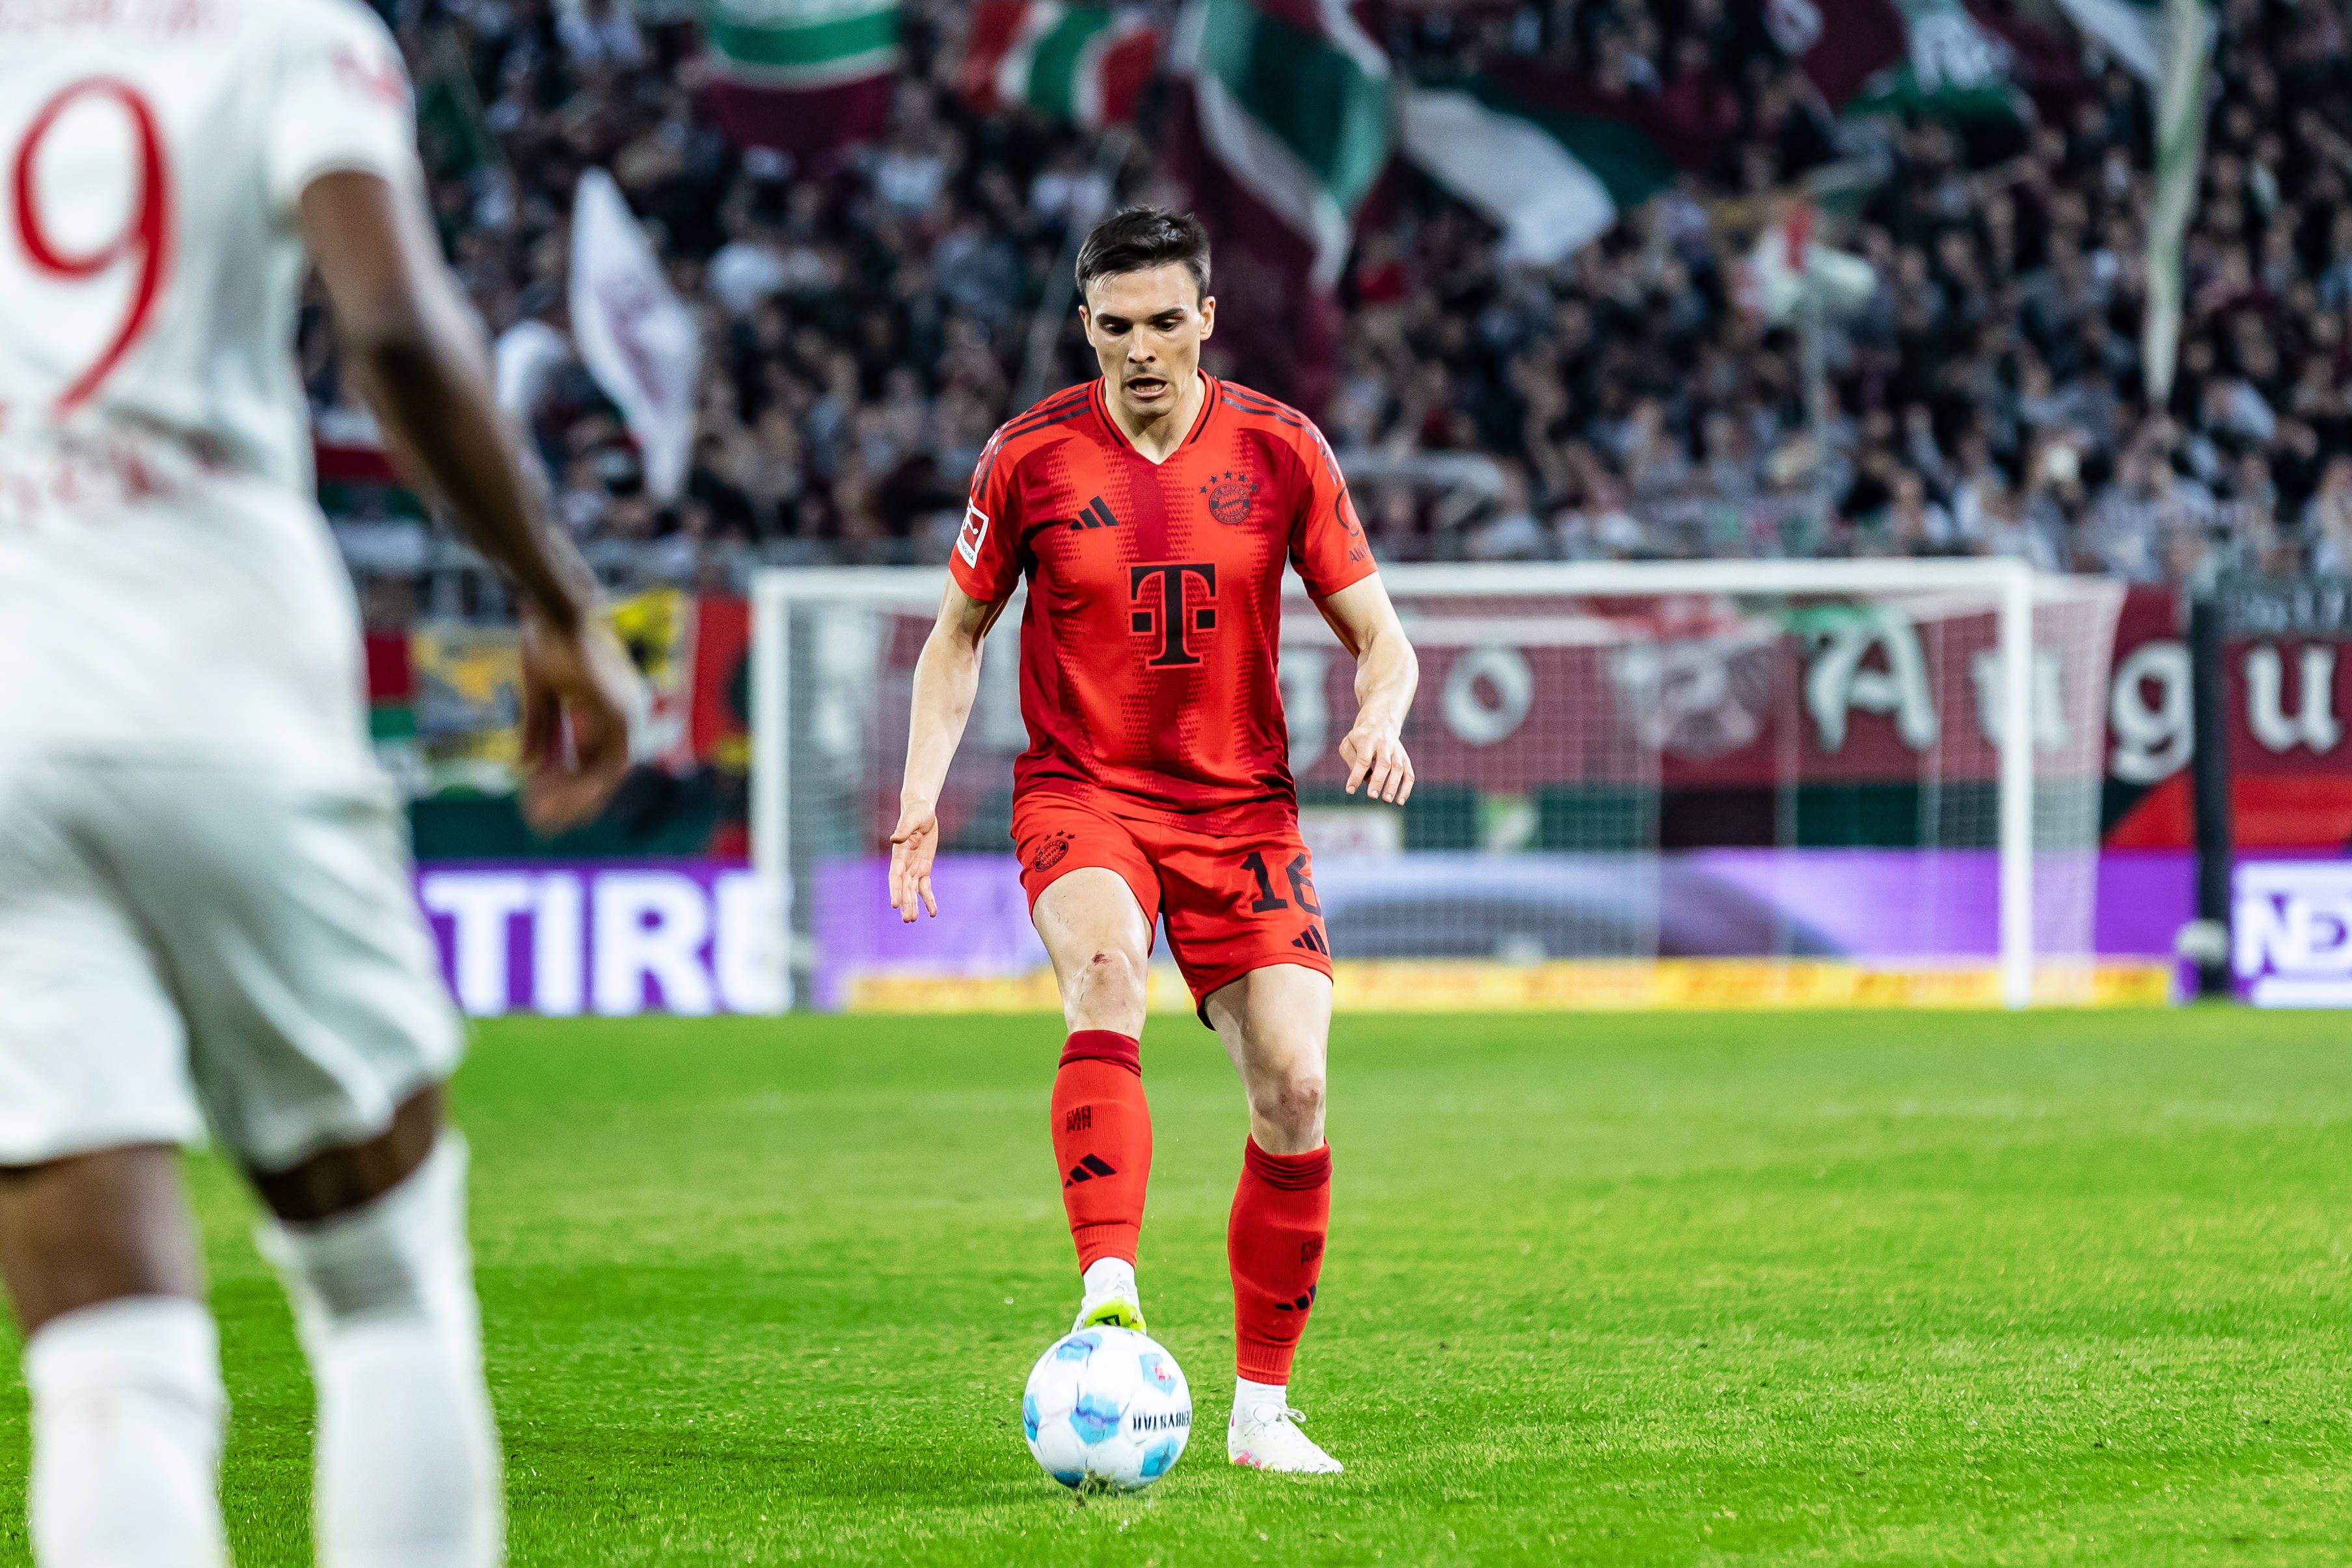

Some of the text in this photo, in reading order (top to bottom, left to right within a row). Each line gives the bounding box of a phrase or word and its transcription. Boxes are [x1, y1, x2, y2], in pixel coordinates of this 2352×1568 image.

[3, 74, 180, 416] 9
[1130, 562, 1217, 667] T
[1239, 851, 1321, 918] 16
